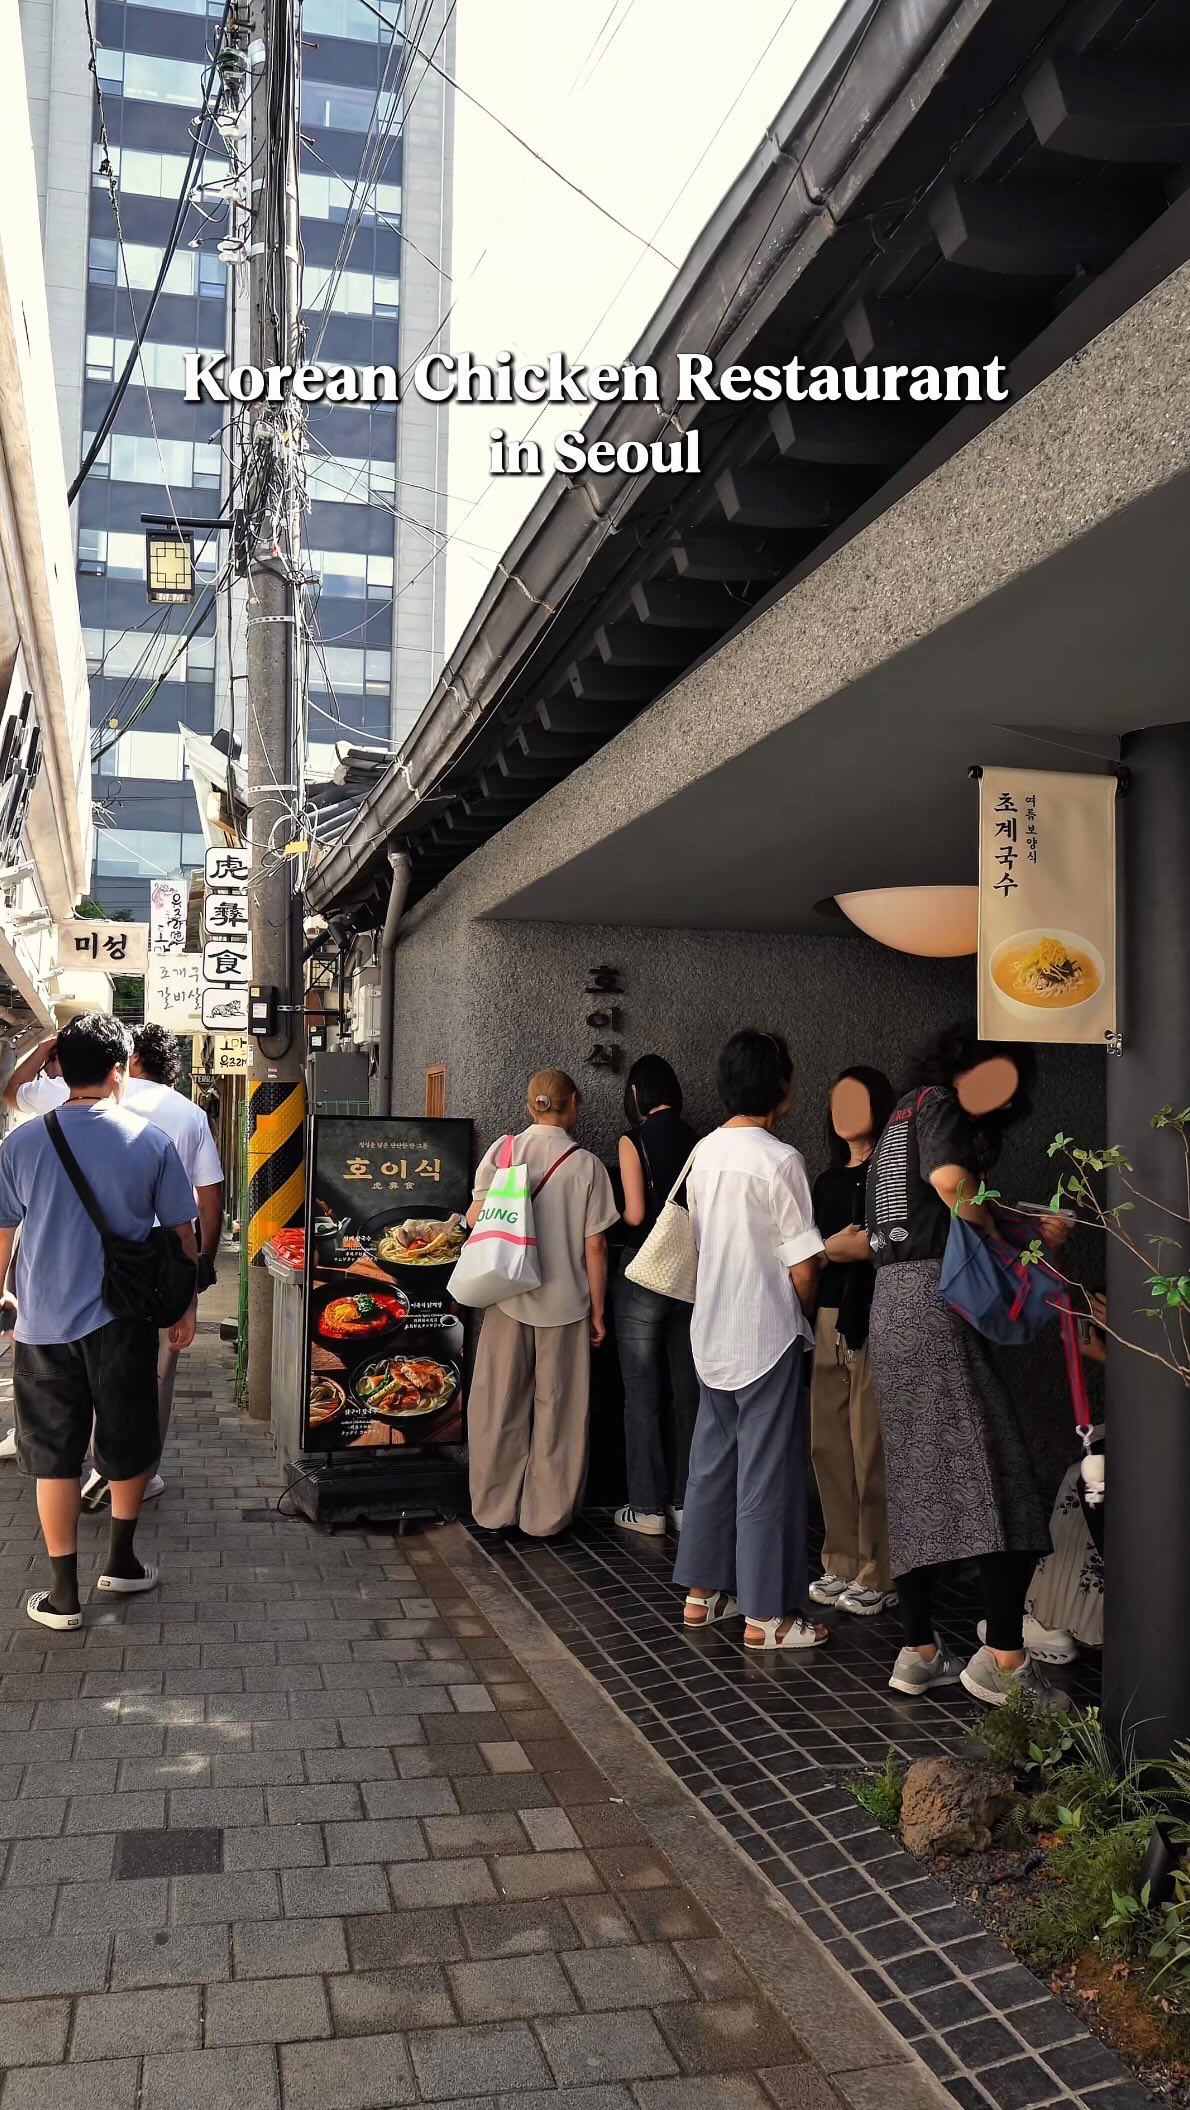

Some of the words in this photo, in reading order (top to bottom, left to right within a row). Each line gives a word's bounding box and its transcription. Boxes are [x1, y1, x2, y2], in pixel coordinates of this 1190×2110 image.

[1025, 794, 1036, 820] 여름
[993, 792, 1018, 897] 초계국수
[1025, 825, 1037, 864] 보양식
[74, 932, 127, 960] 미성
[160, 966, 199, 983] 조개구
[157, 987, 201, 1010] 갈비살
[583, 964, 623, 1073] 호이식
[193, 1075, 216, 1083] TERRA
[895, 1107, 912, 1120] RES
[342, 1157, 441, 1182] 호이식
[477, 1208, 519, 1224] OUNG
